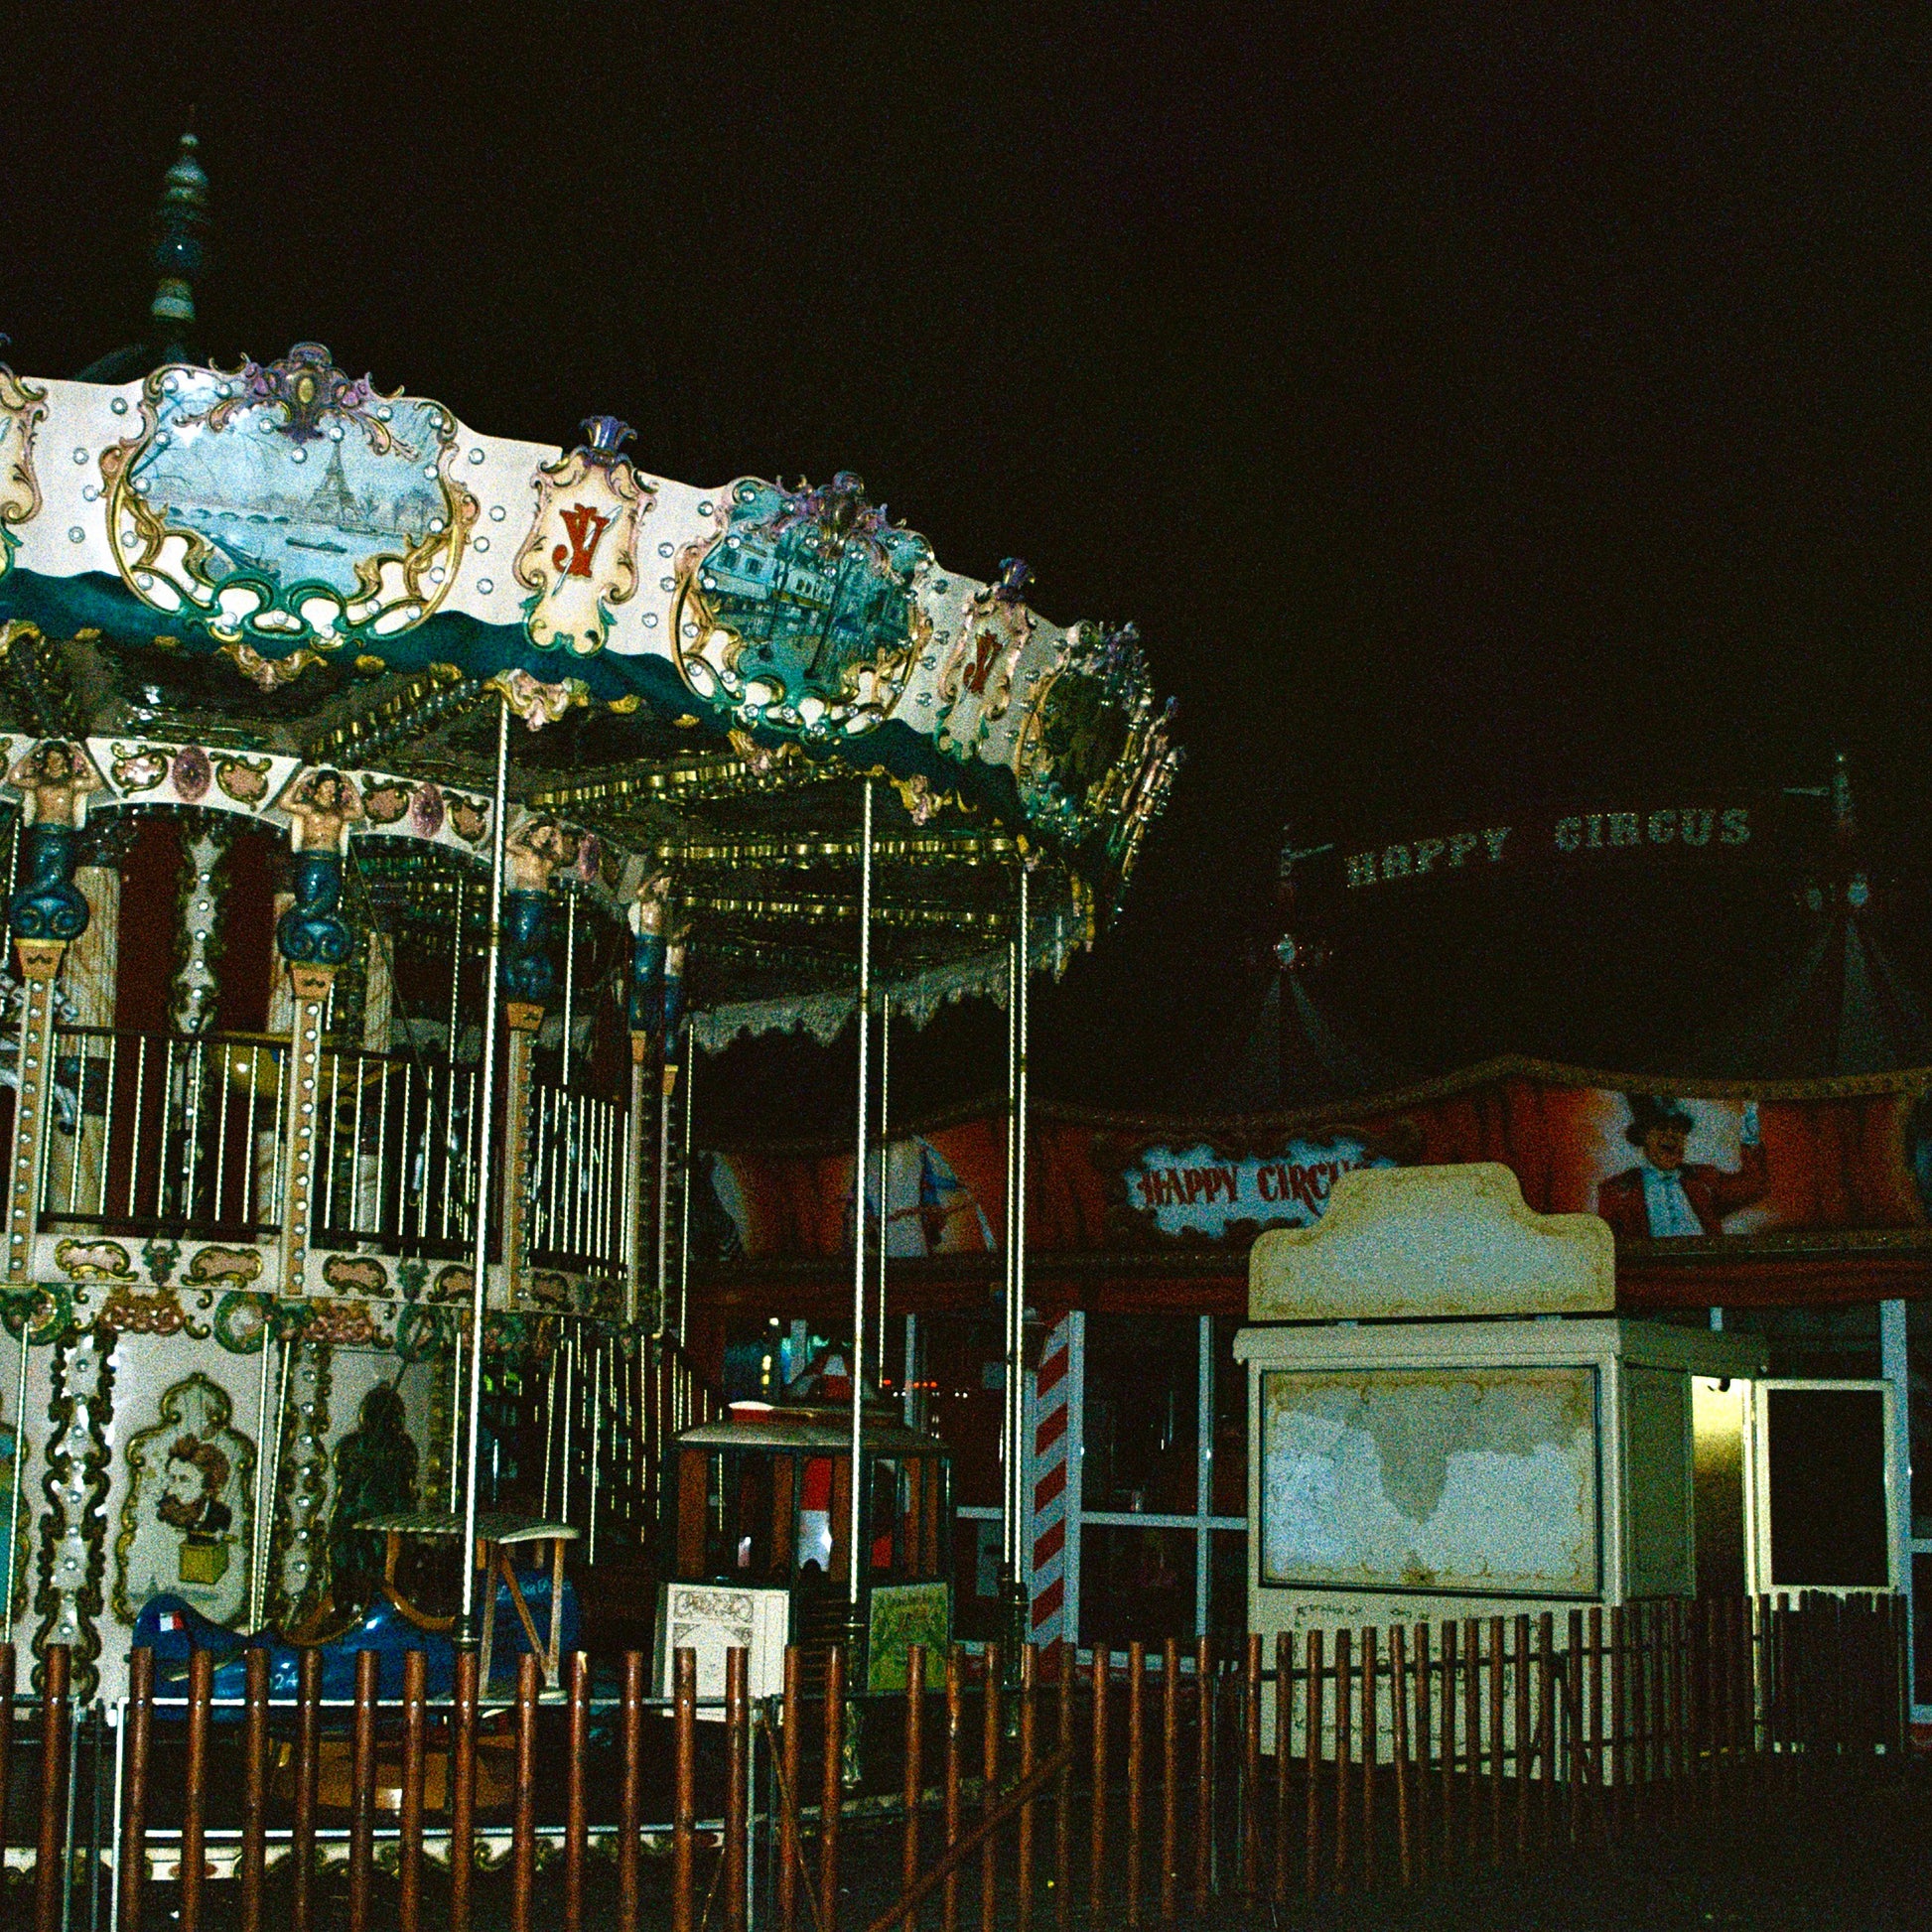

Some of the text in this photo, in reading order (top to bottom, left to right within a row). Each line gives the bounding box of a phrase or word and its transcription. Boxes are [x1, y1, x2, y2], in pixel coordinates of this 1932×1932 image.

[1343, 807, 1752, 889] HAPPY CIRCUS
[1137, 1164, 1239, 1205] HAPPY
